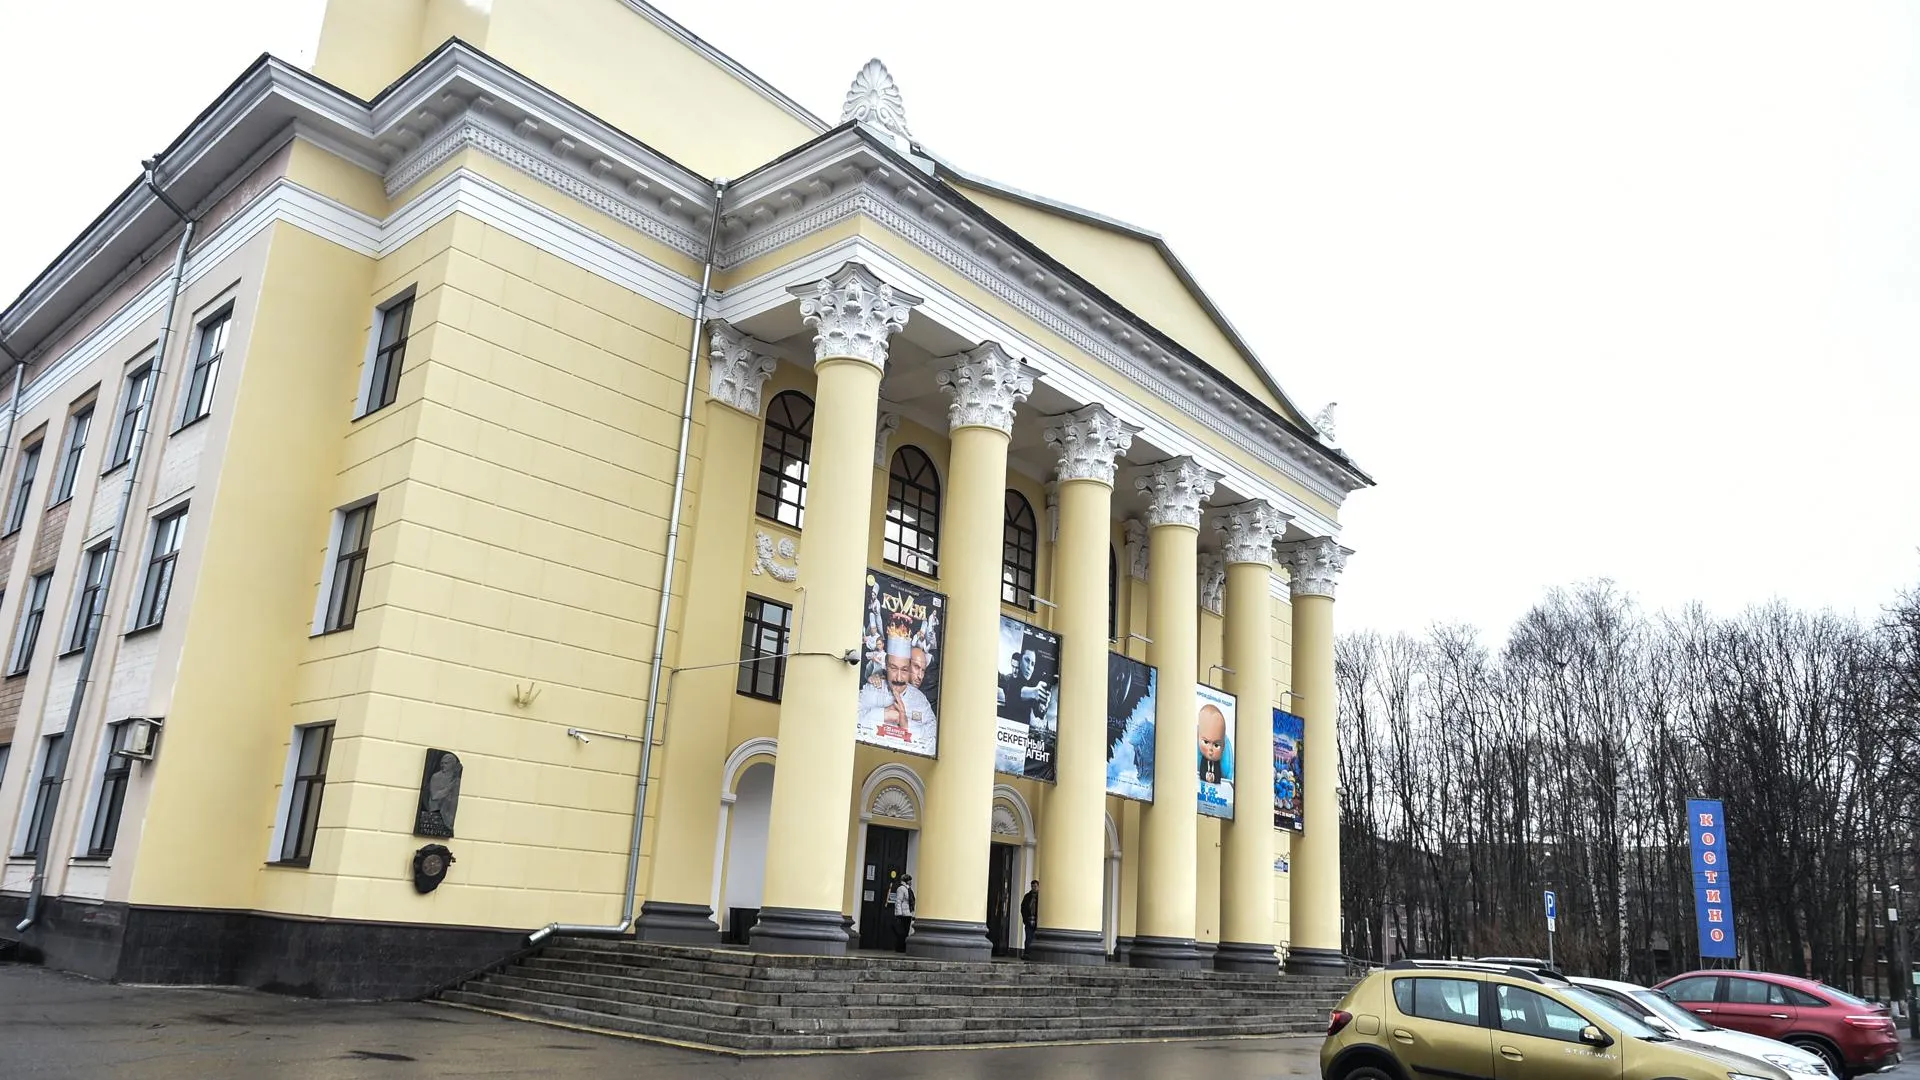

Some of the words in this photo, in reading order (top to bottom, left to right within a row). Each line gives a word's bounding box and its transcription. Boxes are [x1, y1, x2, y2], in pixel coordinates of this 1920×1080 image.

[997, 730, 1045, 752] СЕКРЕТНЫЙ
[1025, 748, 1050, 763] АГЕНТ
[1699, 813, 1724, 943] КОСТИНО
